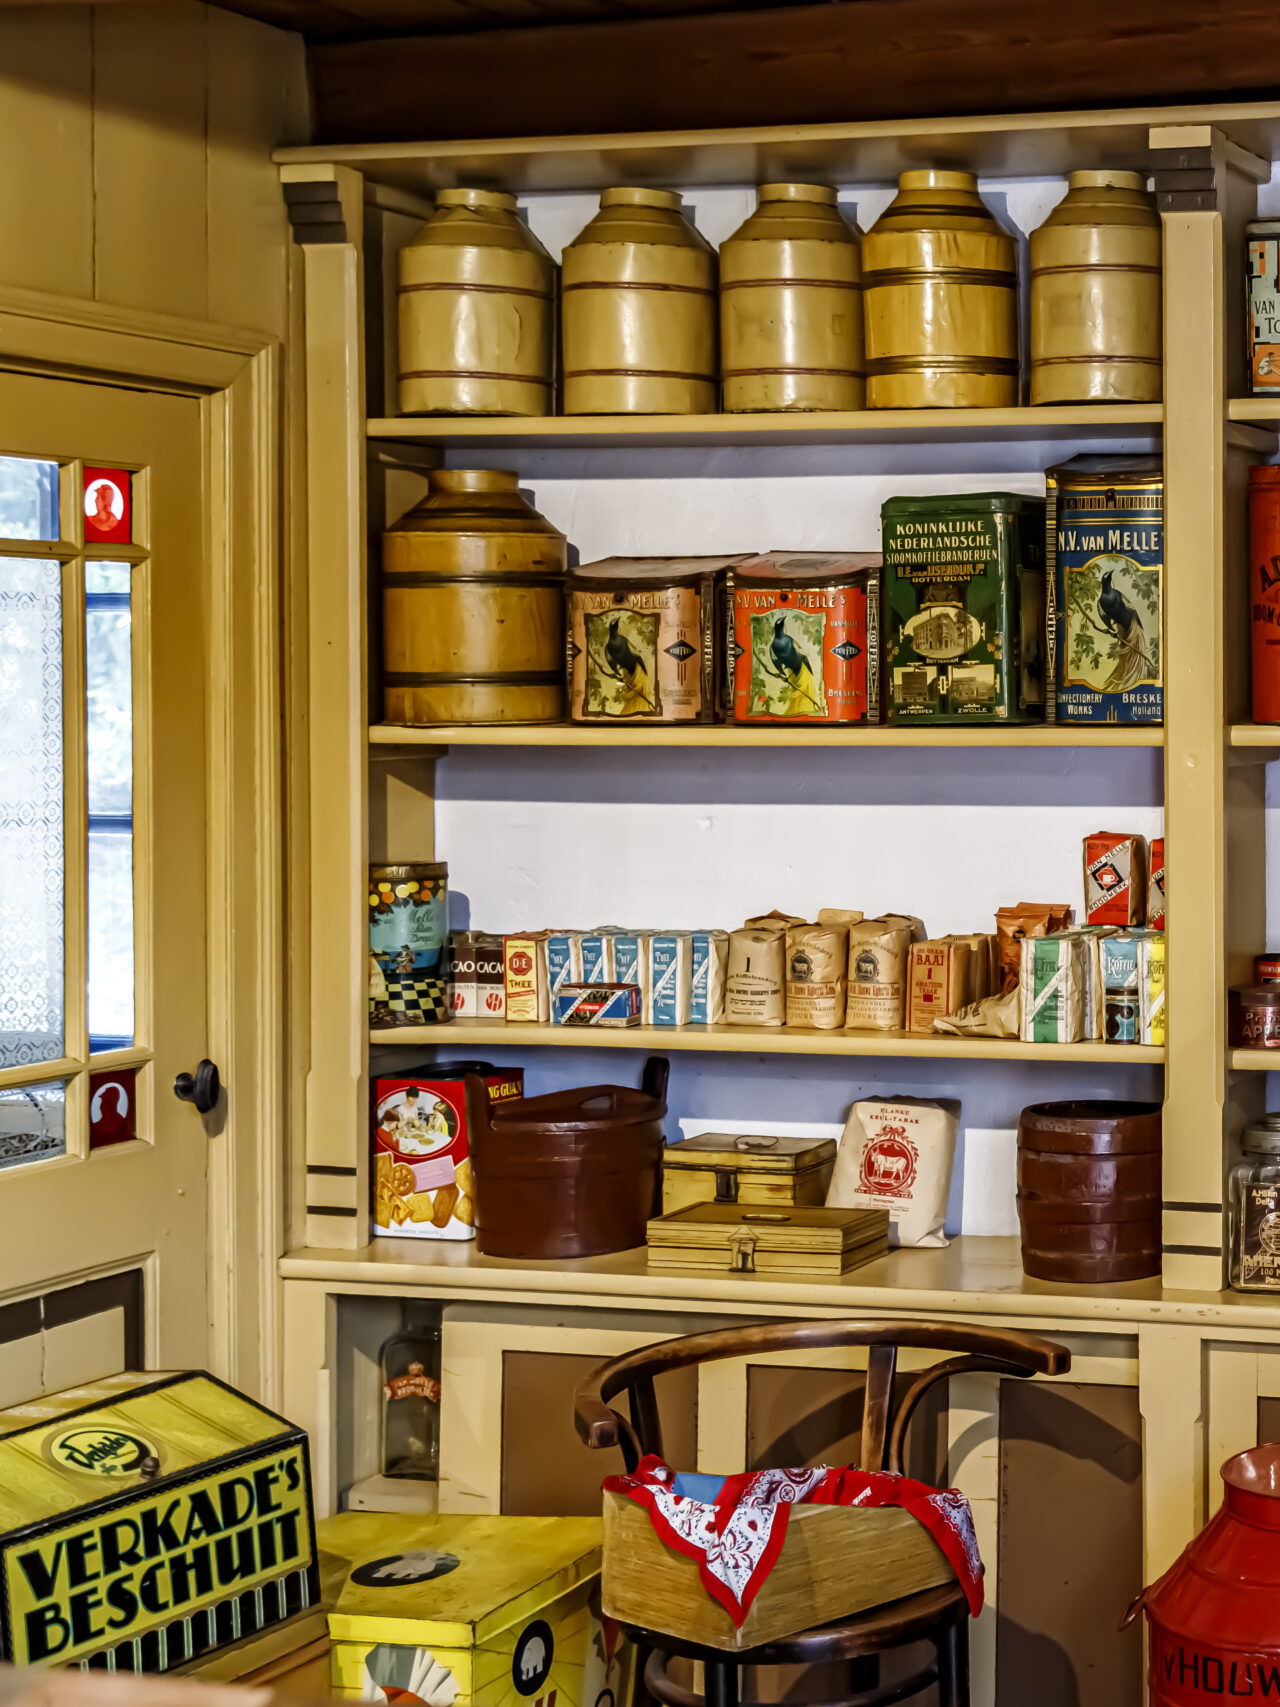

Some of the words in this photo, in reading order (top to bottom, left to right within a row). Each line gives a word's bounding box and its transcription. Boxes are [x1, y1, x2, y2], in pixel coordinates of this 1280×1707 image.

[1255, 300, 1275, 314] VAN
[896, 520, 985, 536] KONINKLIJKE
[889, 534, 993, 550] NEDERLANDSCHE
[1081, 536, 1104, 551] VAN
[755, 594, 776, 608] VAN
[1122, 693, 1162, 704] BRESKE
[1067, 704, 1093, 715] WORKS
[1088, 859, 1103, 872] VAN
[1104, 842, 1127, 858] NELLE
[509, 979, 533, 988] THEE
[16, 1455, 301, 1603] VERKADE'S
[24, 1507, 301, 1666] BESCHUIT
